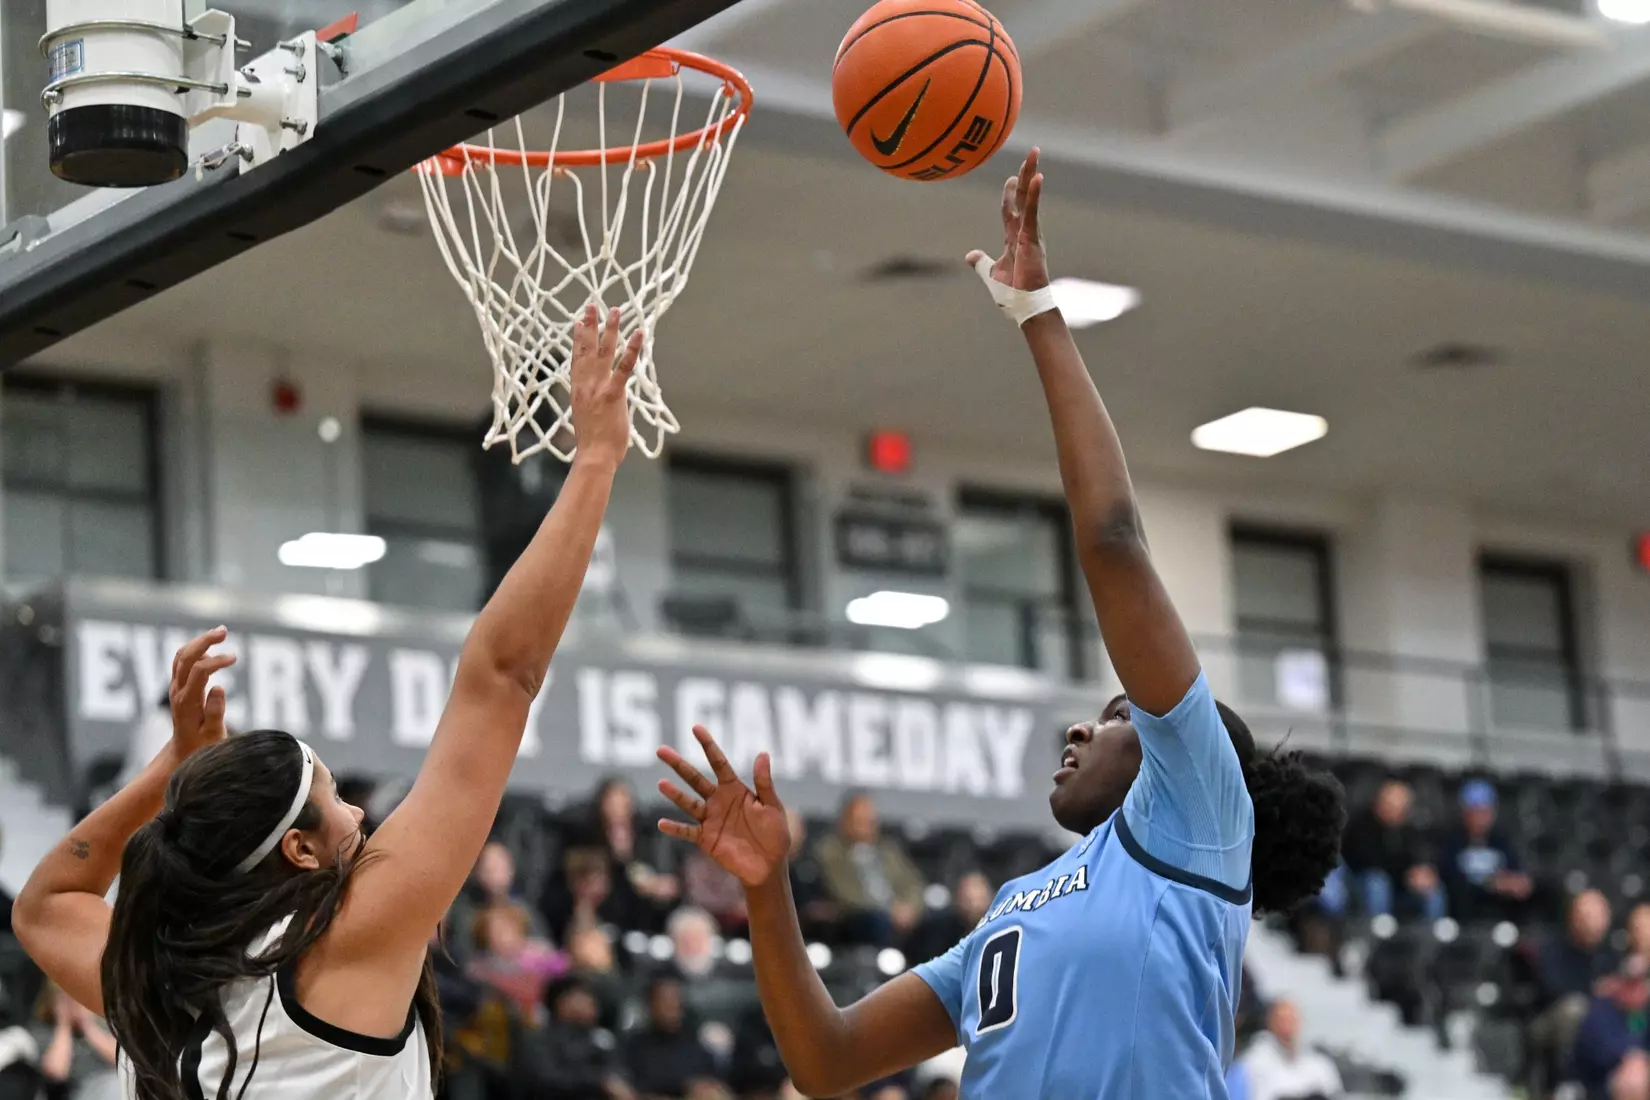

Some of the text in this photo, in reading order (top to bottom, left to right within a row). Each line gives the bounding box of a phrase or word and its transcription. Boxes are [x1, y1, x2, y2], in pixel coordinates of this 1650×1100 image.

[908, 115, 993, 180] ELITE
[575, 665, 664, 767] IS
[675, 677, 1034, 799] GAMEDAY
[976, 925, 1023, 1036] 0
